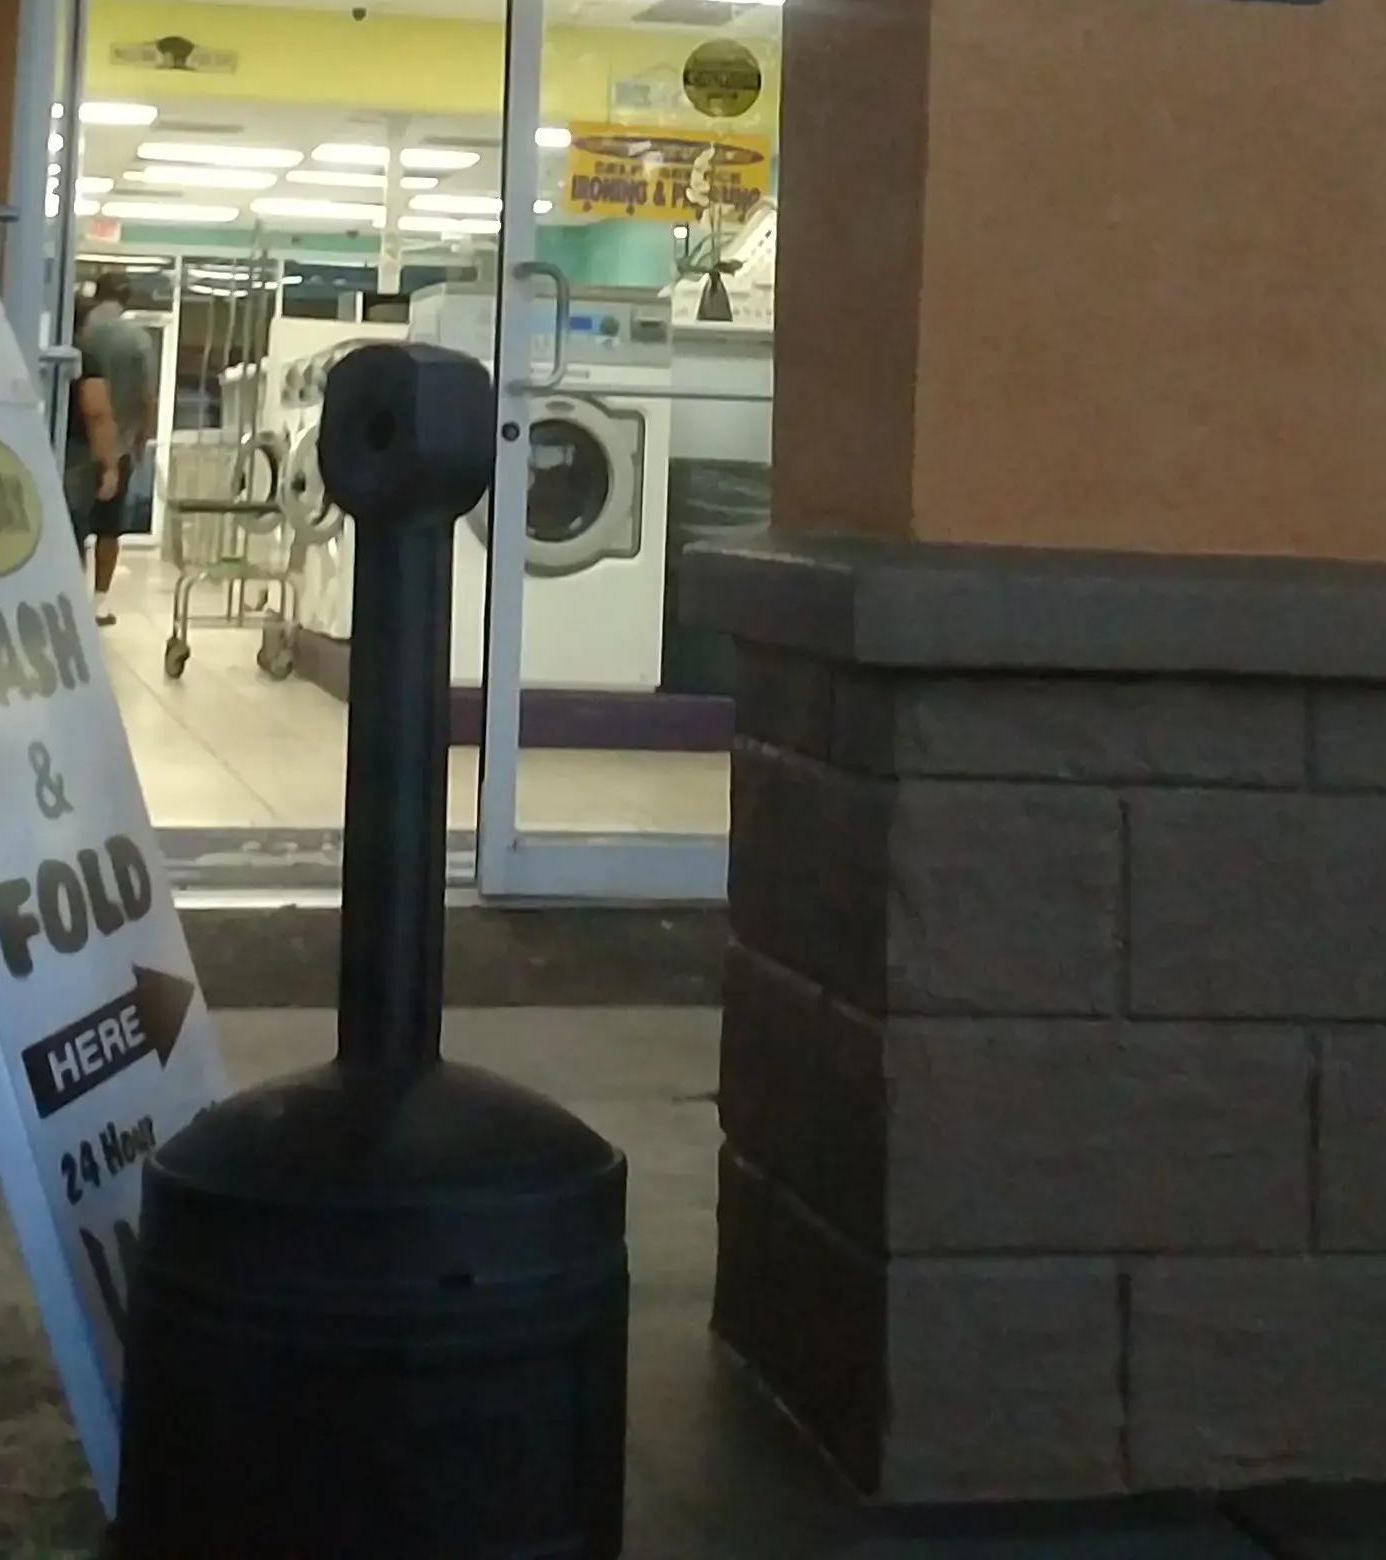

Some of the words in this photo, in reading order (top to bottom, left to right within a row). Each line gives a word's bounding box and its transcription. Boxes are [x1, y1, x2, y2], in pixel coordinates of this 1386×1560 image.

[28, 739, 75, 820] &
[47, 1004, 147, 1095] HERE
[60, 1139, 101, 1207] 24
